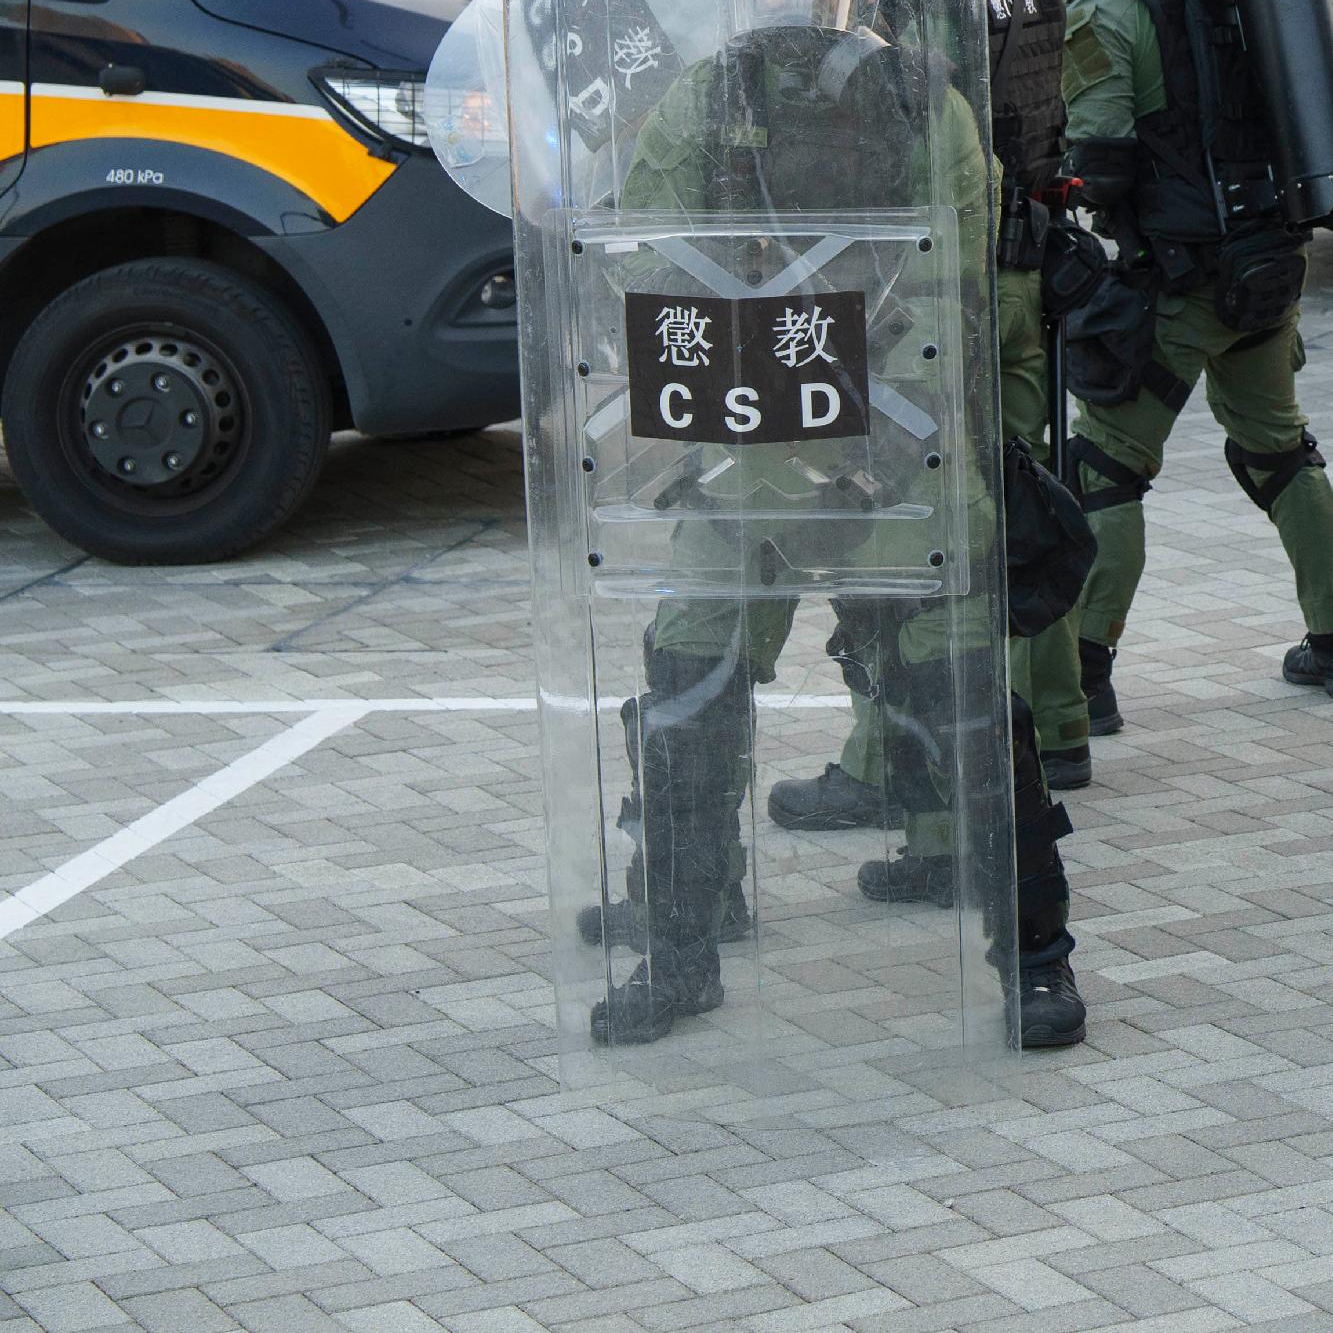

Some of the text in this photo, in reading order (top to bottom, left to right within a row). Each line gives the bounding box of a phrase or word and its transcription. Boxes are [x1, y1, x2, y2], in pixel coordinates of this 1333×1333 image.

[105, 168, 164, 184] 480 kPa
[655, 305, 838, 368] 懲教
[659, 382, 841, 433] CSD
